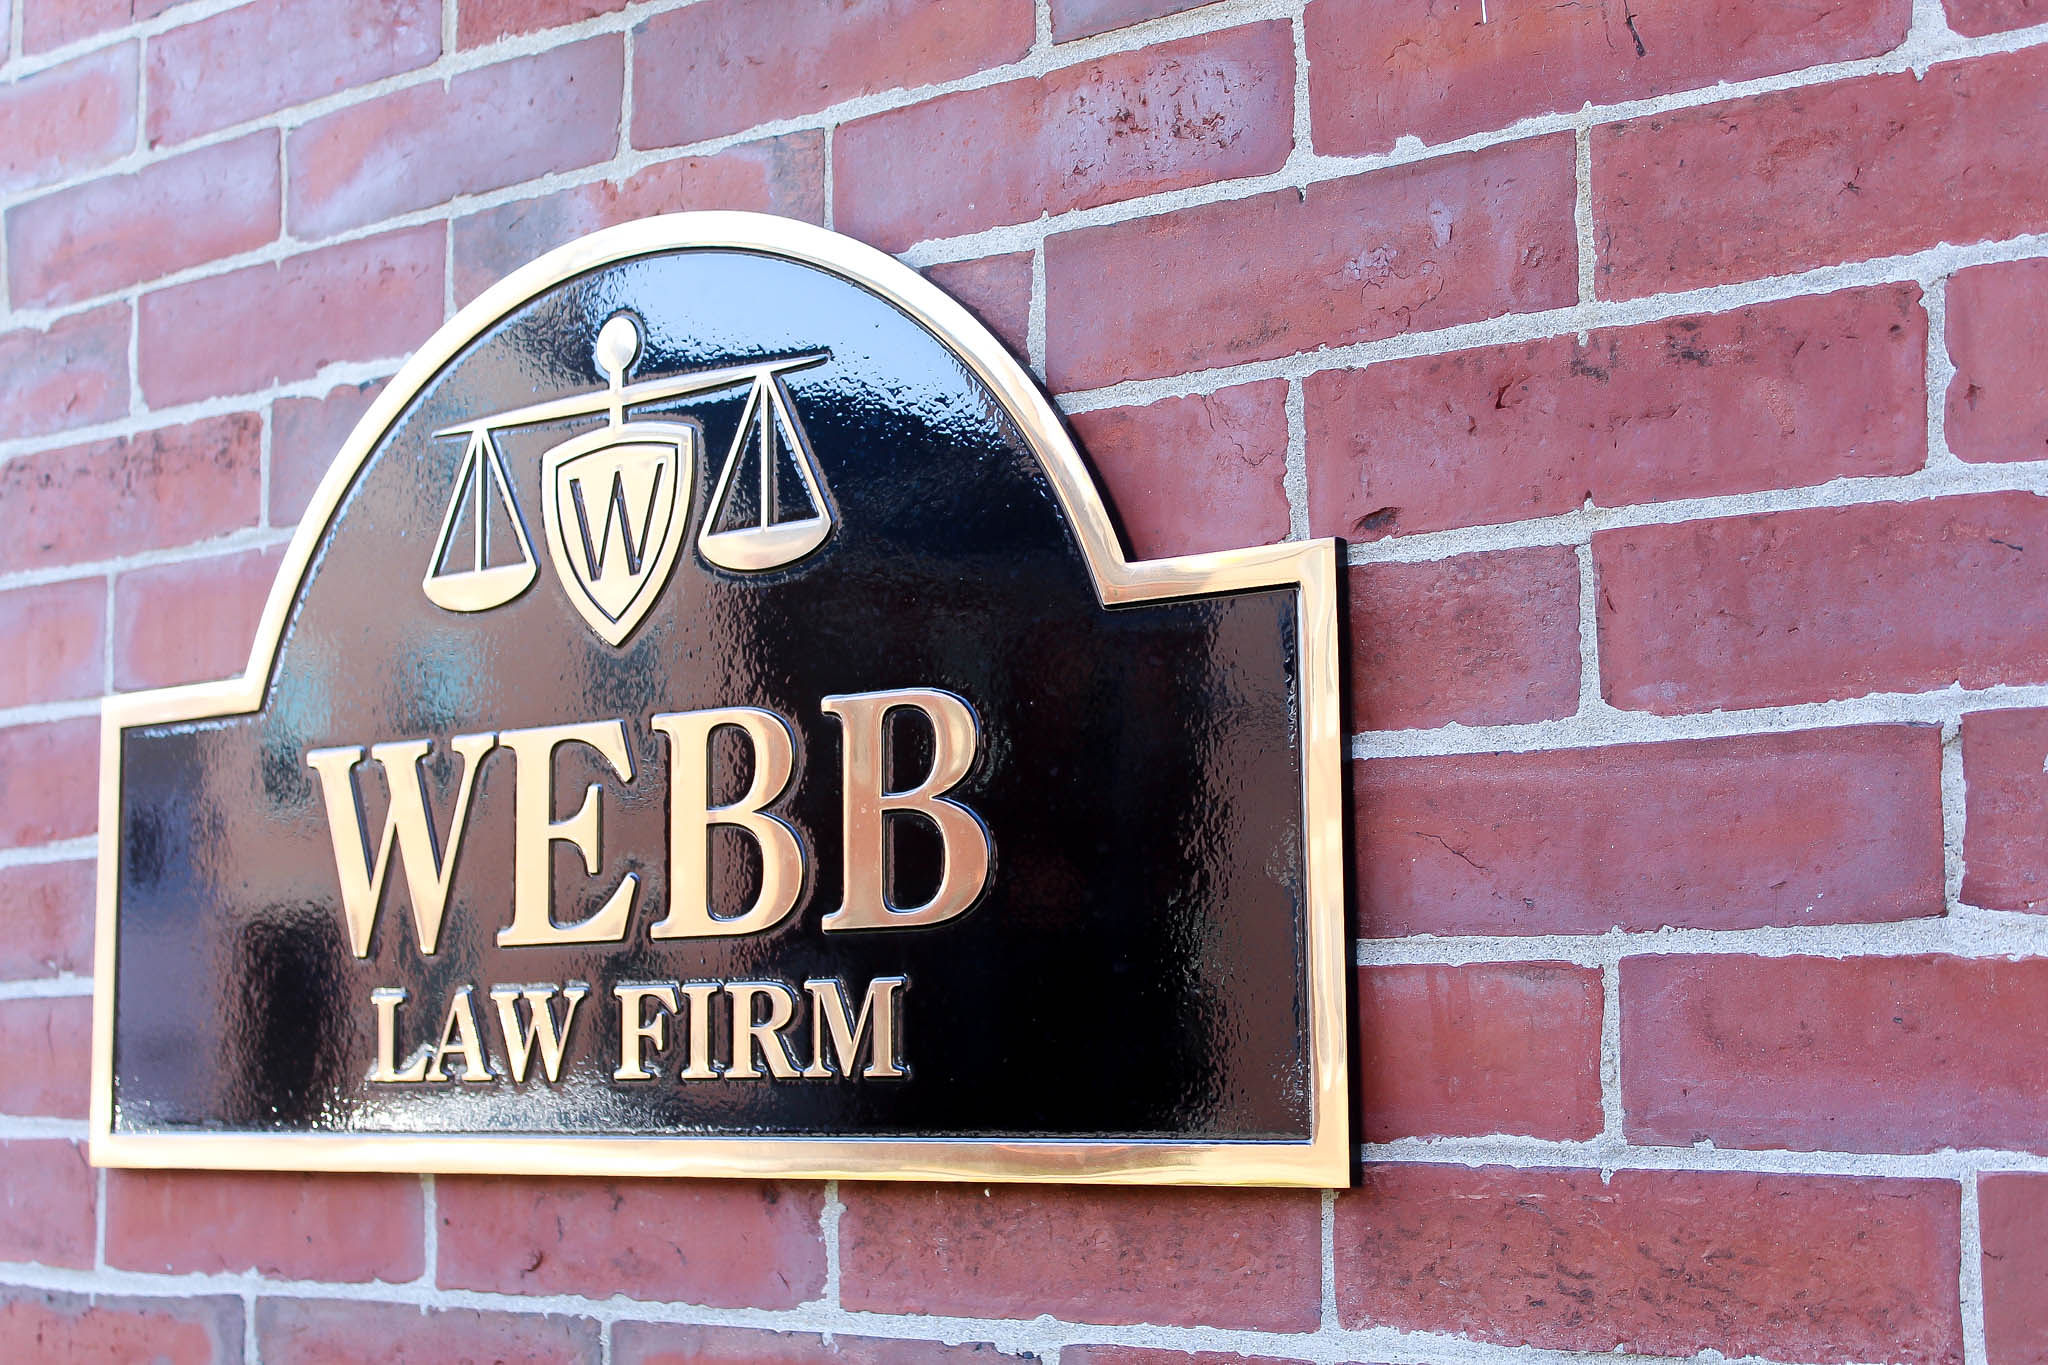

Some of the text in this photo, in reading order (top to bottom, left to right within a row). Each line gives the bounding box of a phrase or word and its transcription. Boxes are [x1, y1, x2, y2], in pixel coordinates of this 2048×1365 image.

[568, 462, 664, 581] W
[306, 687, 993, 959] WEBB
[370, 976, 905, 1083] LAW FIRM
